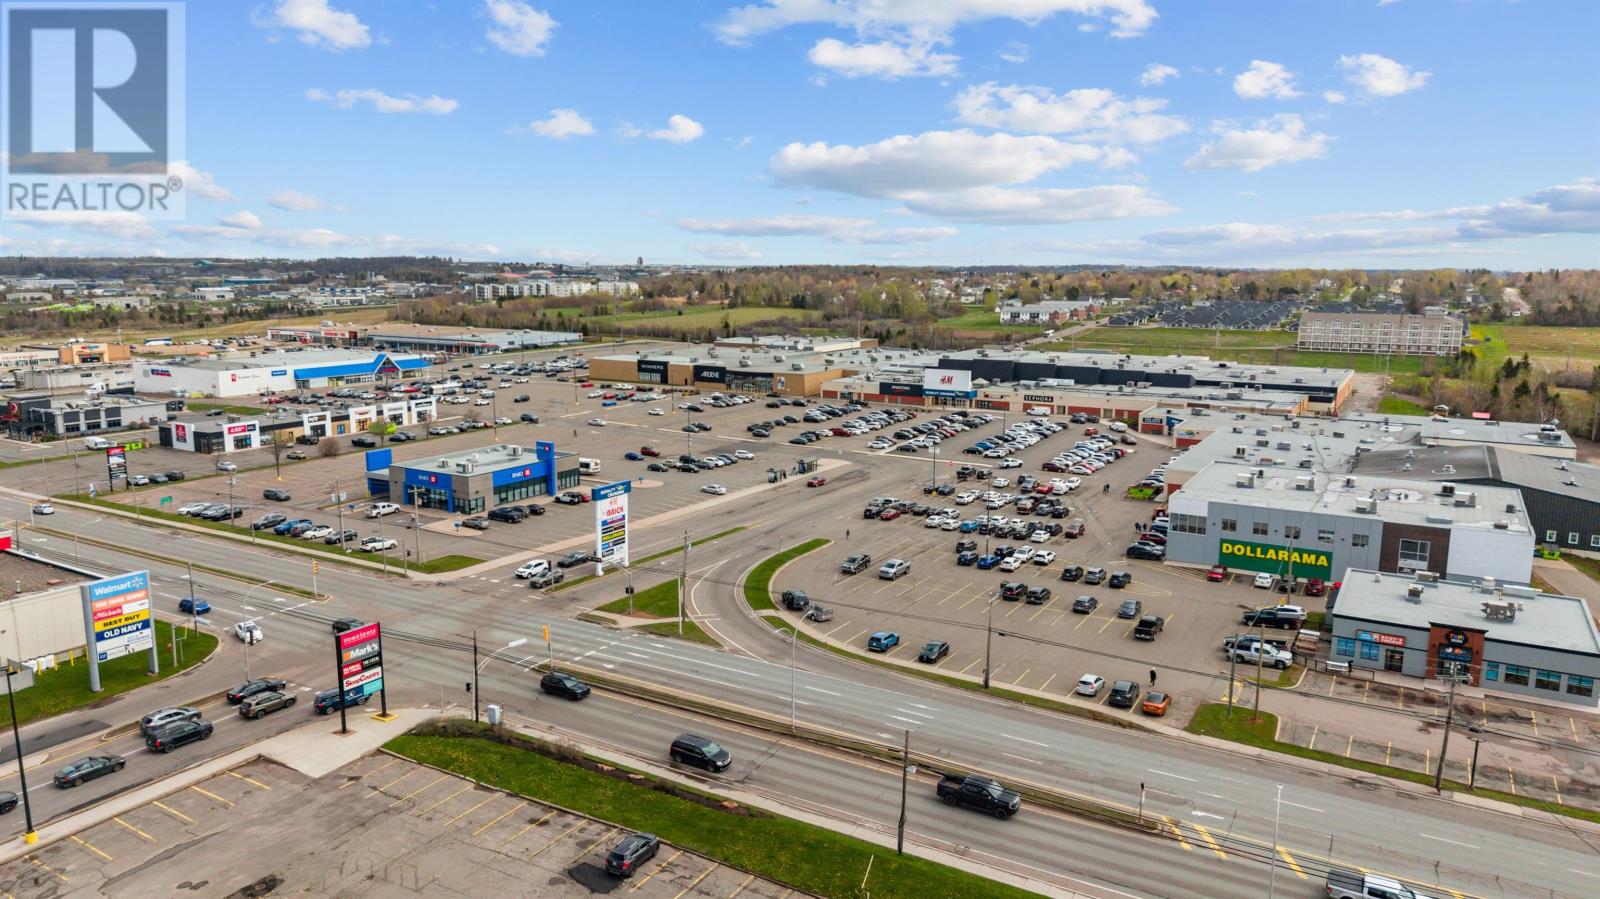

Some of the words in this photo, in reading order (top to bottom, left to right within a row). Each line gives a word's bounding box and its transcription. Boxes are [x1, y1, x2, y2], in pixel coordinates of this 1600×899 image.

[606, 505, 624, 517] BRICK
[1222, 543, 1329, 567] DOLLARAMA
[94, 580, 132, 596] Walmart
[103, 618, 123, 627] BEST
[124, 614, 141, 622] BUY
[104, 628, 120, 638] OLD
[121, 622, 143, 634] NAVY
[350, 642, 379, 659] Mark's
[345, 671, 380, 688] SleepCountry
